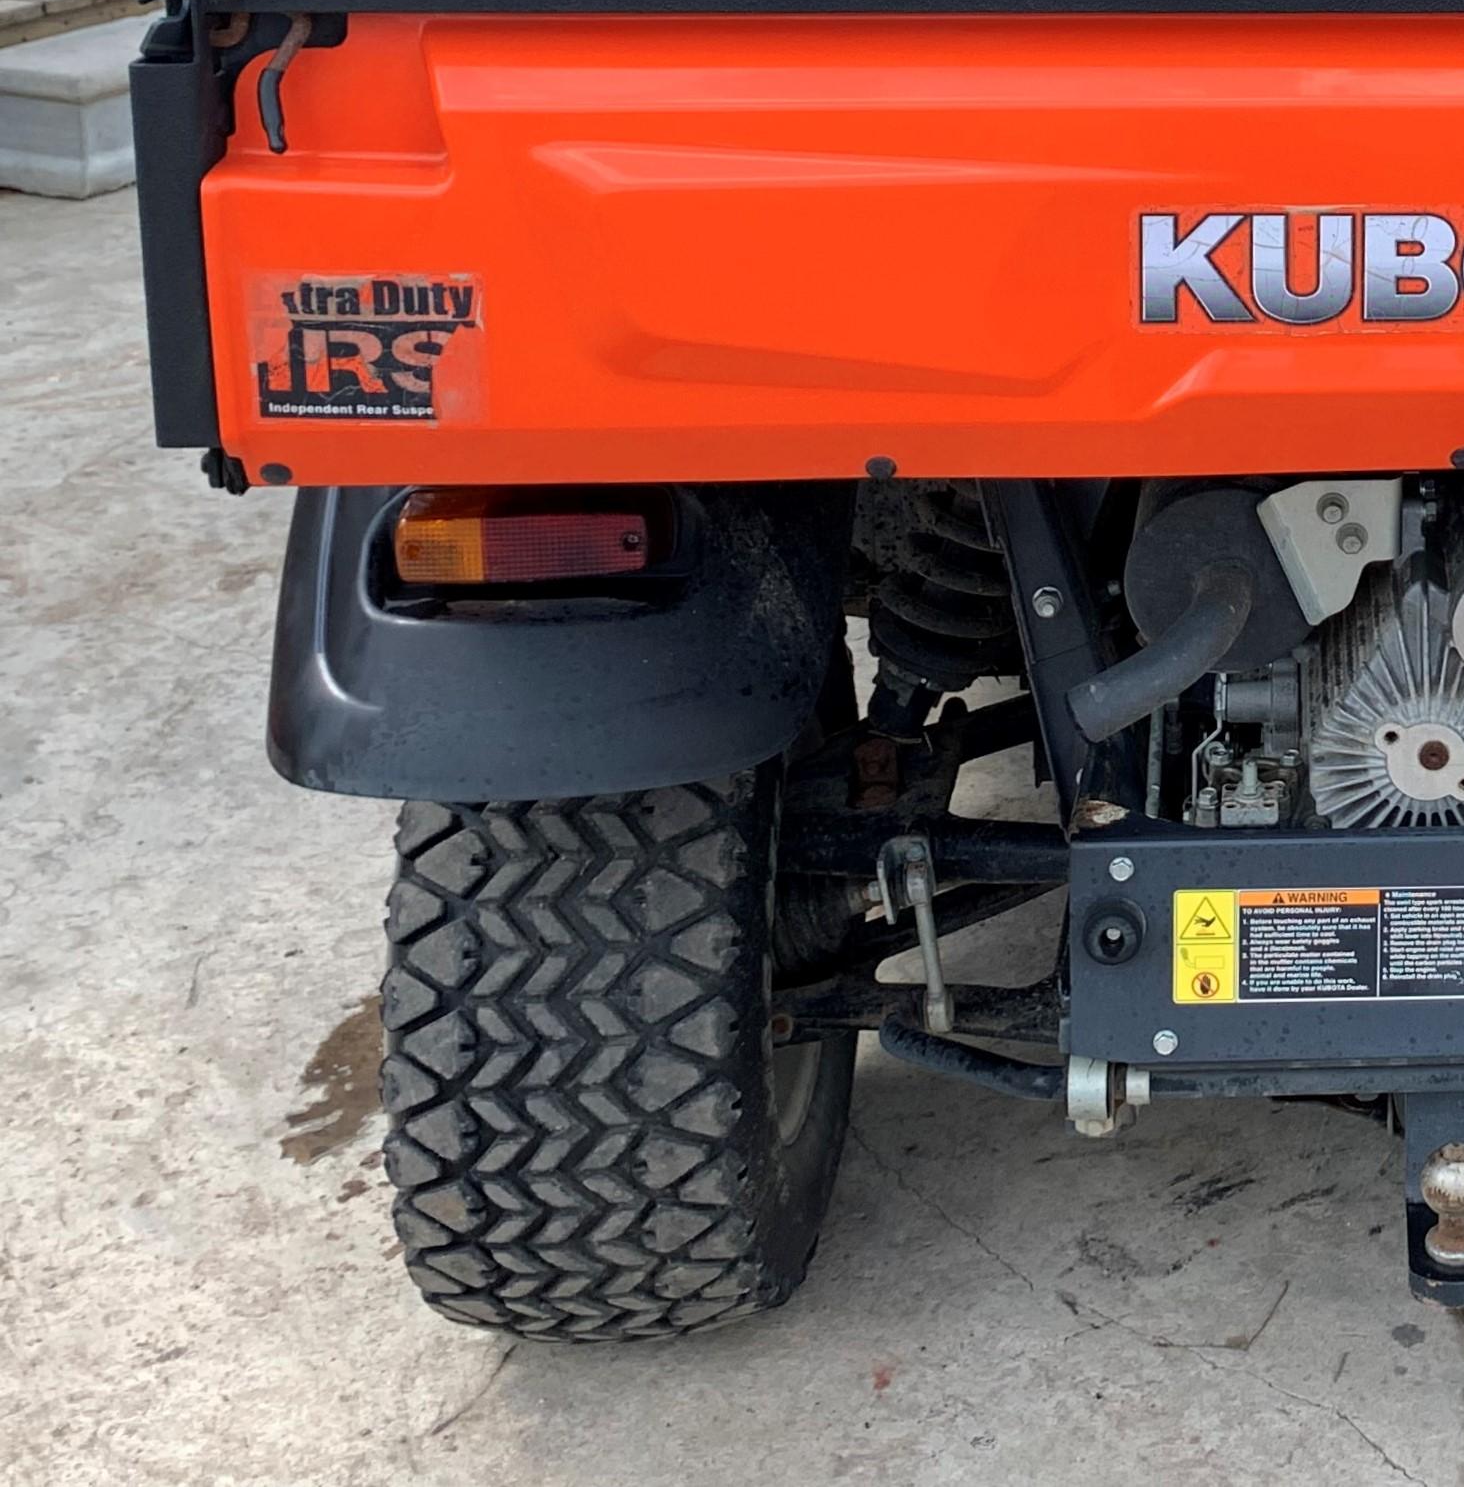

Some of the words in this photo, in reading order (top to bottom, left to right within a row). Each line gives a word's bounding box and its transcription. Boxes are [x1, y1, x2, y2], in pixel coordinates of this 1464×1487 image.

[372, 280, 474, 318] Duty
[268, 402, 353, 416] Independent
[357, 402, 388, 415] Rear
[1287, 892, 1347, 902] WARNING
